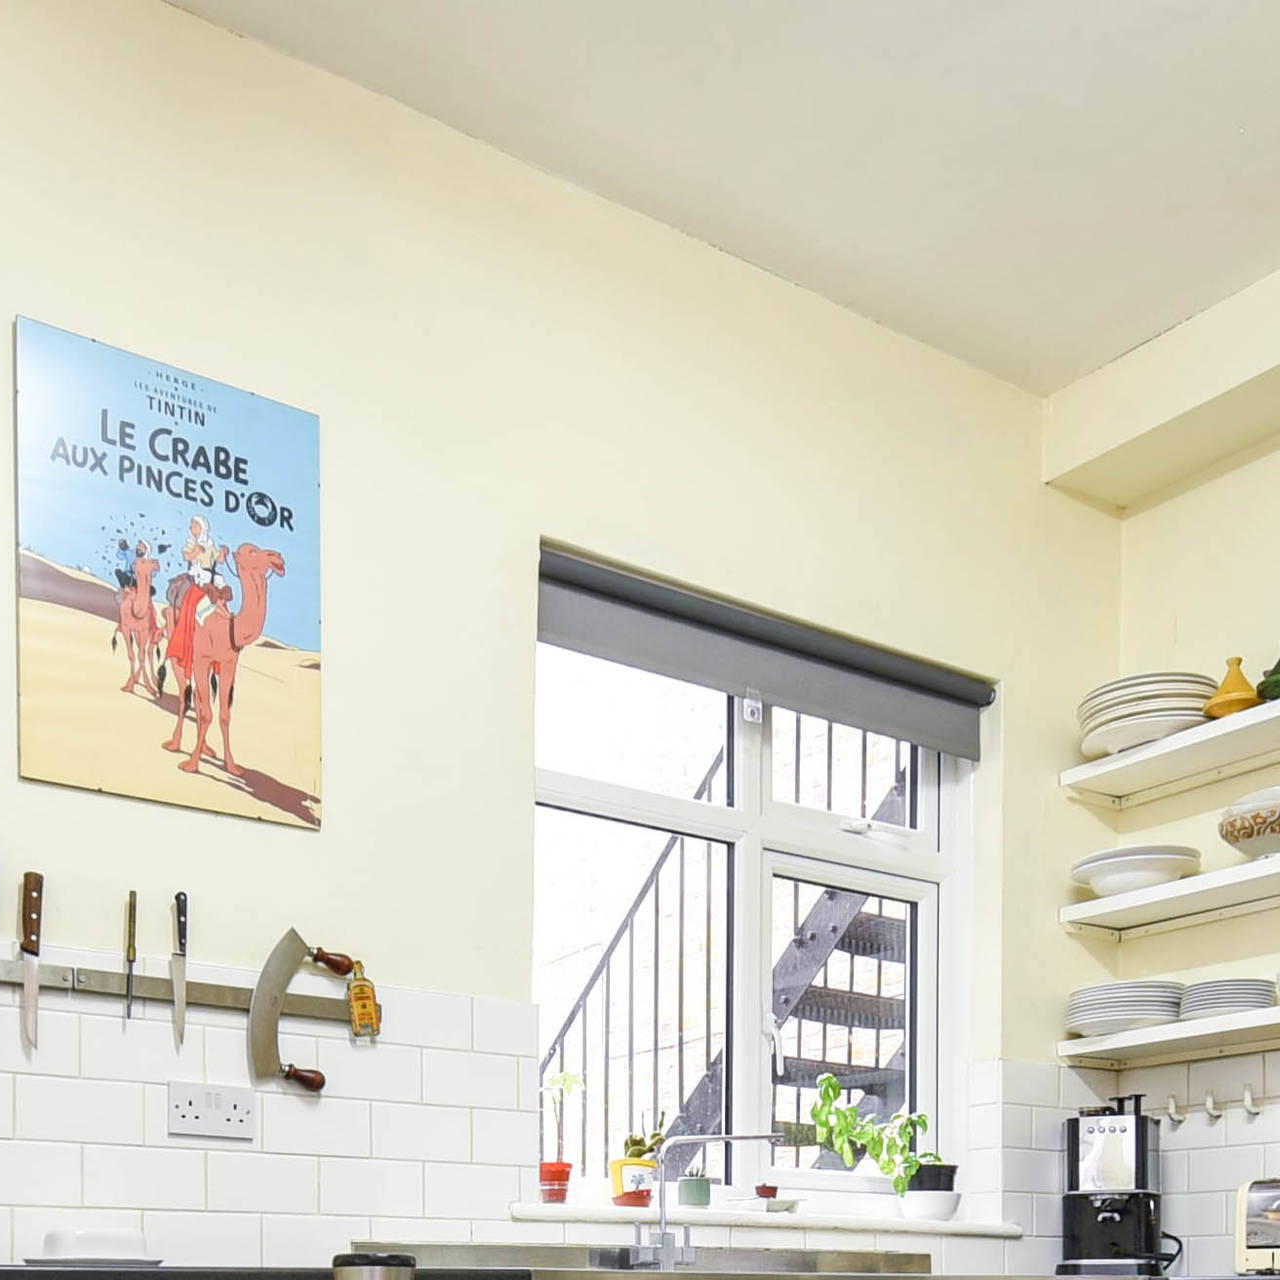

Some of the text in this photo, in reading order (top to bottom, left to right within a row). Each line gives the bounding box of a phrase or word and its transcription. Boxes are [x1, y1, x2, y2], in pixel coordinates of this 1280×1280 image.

[146, 394, 206, 427] TINTIN
[153, 386, 204, 410] AVENTURES
[100, 408, 250, 486] LE CRABE
[50, 436, 294, 532] AUX PINCES D'OR
